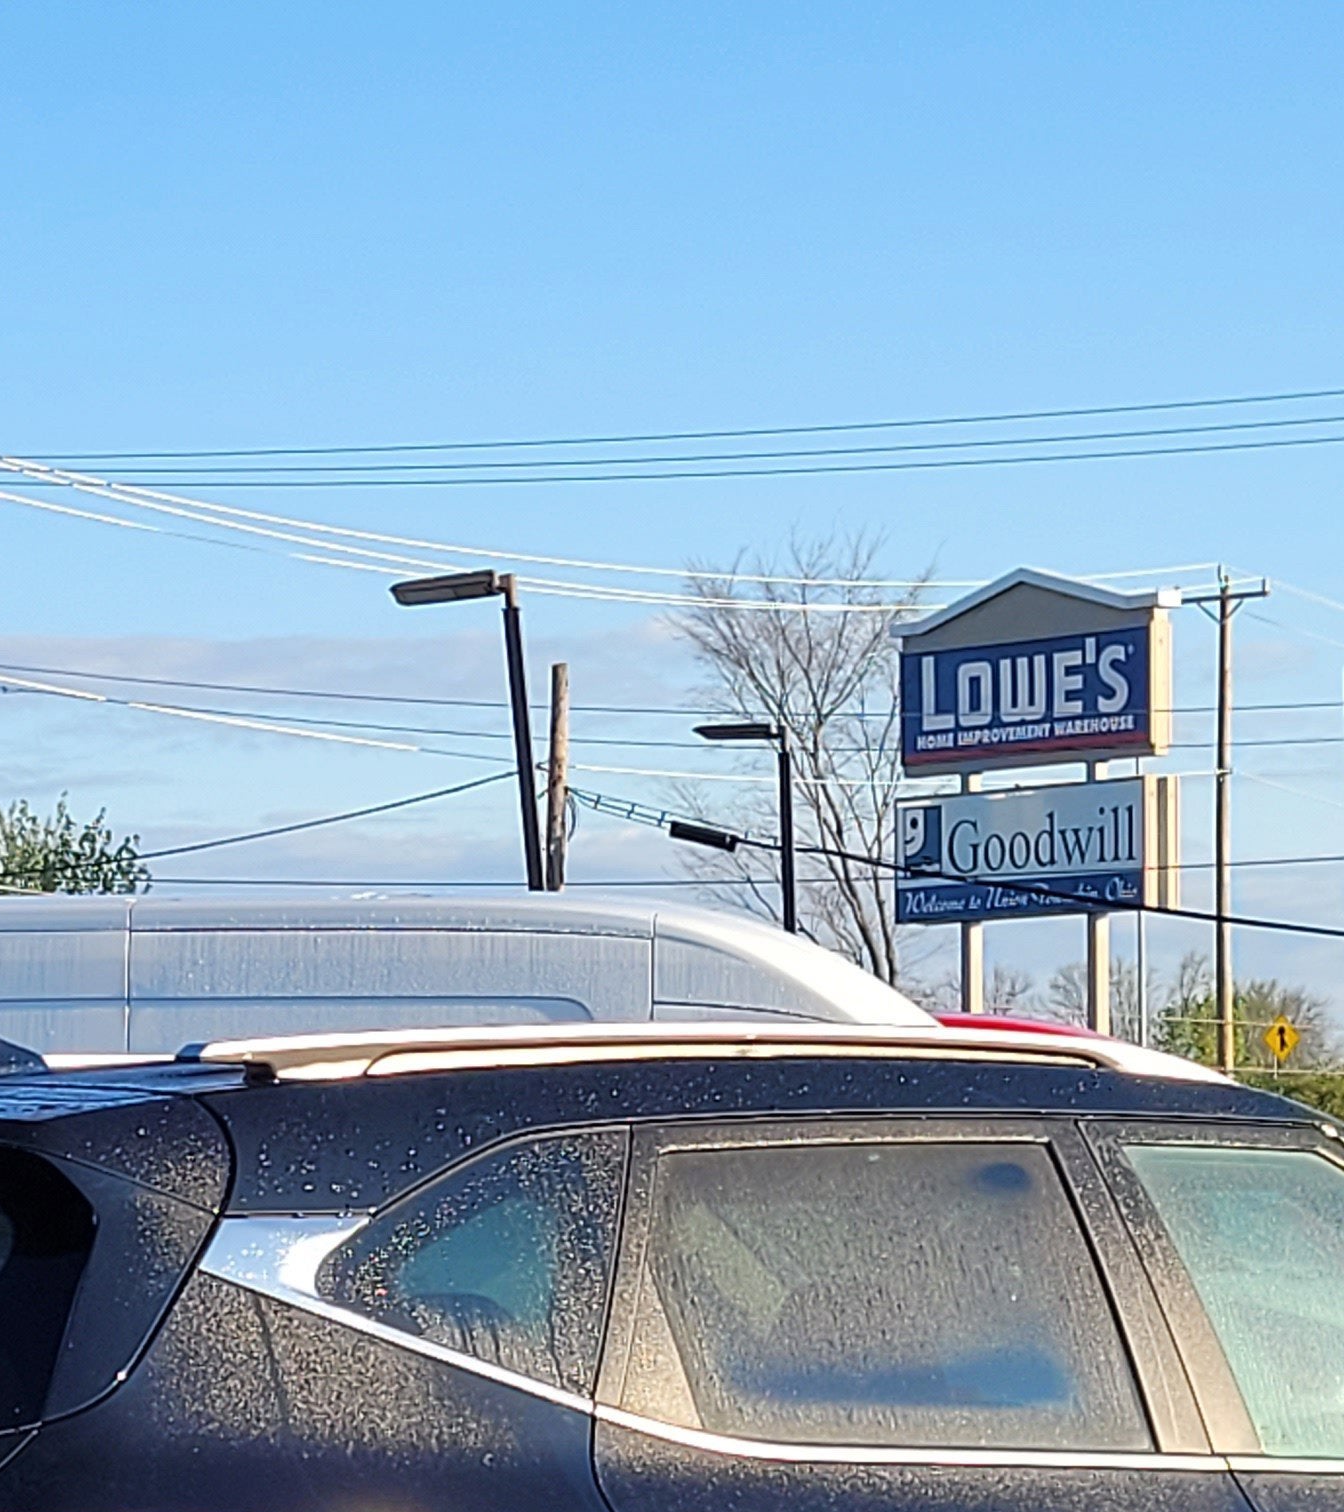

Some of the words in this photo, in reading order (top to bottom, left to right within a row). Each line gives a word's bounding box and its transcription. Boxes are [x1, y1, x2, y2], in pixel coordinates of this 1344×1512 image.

[921, 637, 1129, 732] LOWE'S
[917, 733, 954, 750] HOME
[958, 722, 1051, 746] IMPROVEMENT
[1054, 715, 1135, 738] WAREHOUSE
[948, 804, 1137, 874] Goodwill
[905, 891, 966, 914] Welcome
[968, 895, 982, 910] to
[985, 886, 1028, 909] Union
[1105, 876, 1138, 902] Ohio
